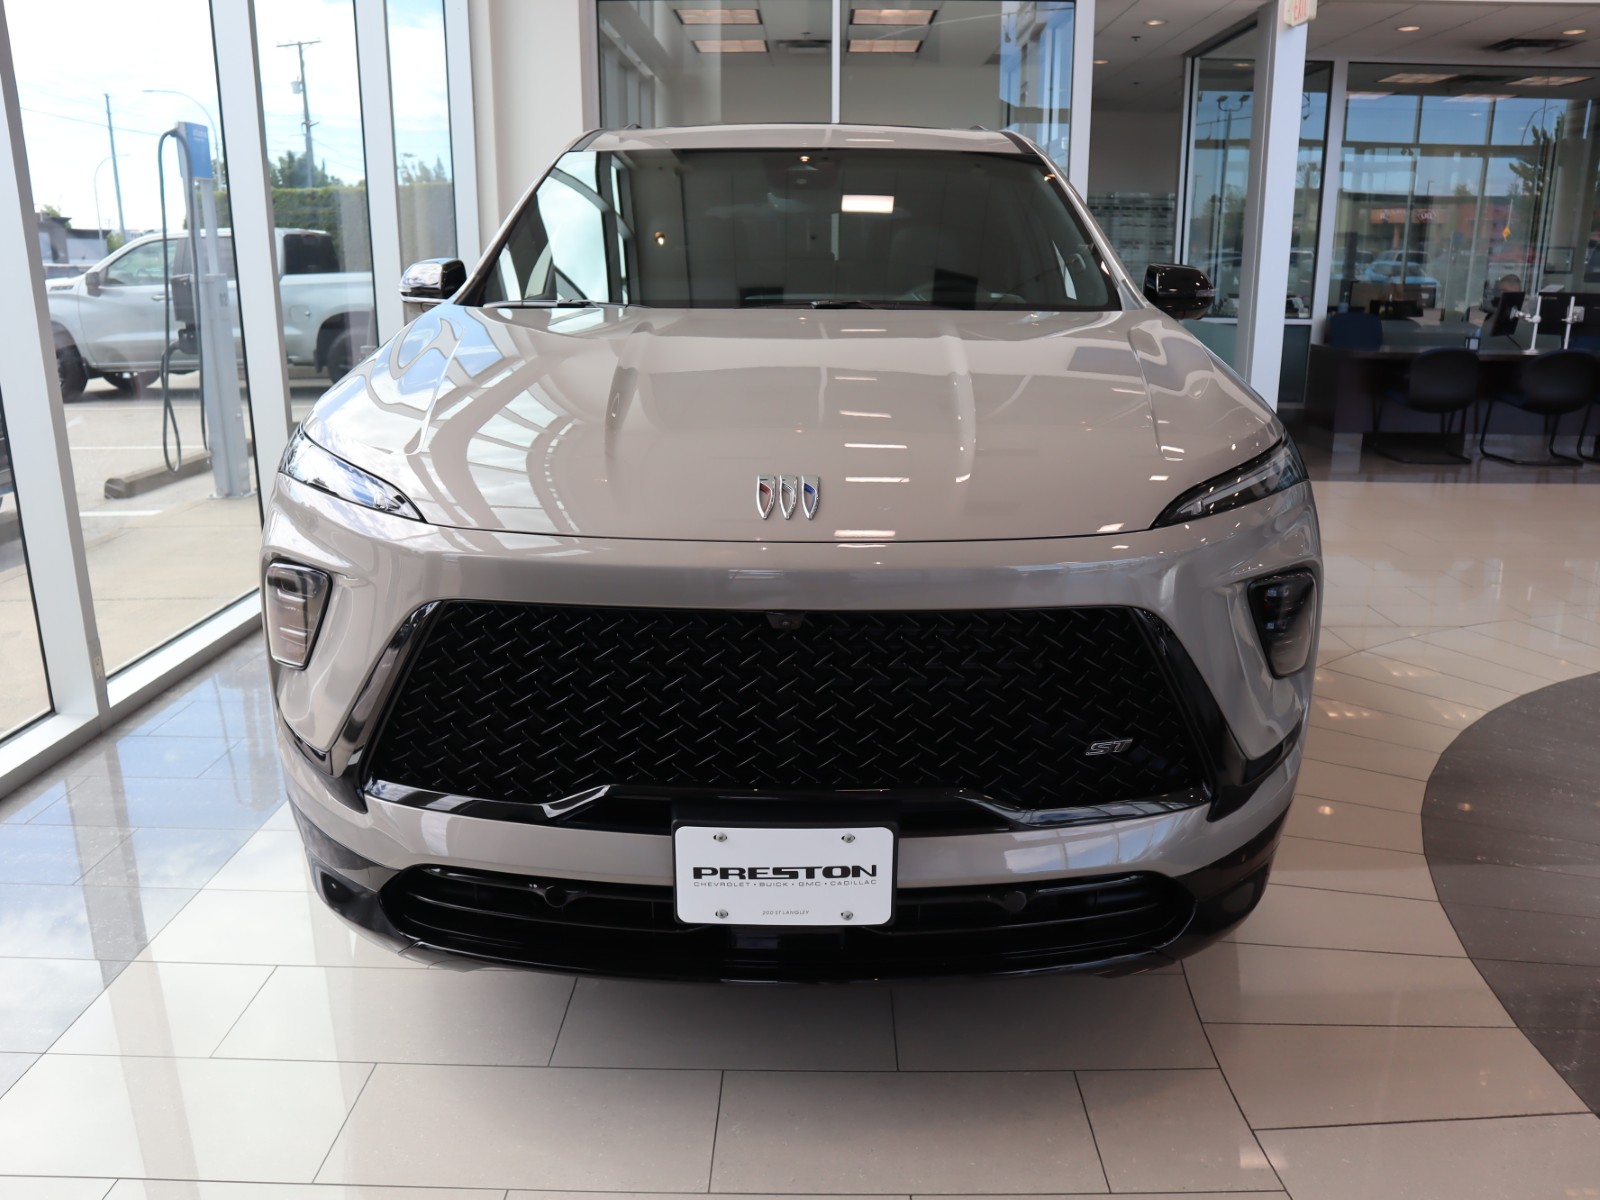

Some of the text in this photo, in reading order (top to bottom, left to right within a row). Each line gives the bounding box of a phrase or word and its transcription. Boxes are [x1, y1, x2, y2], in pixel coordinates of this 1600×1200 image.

[1085, 738, 1134, 756] ST
[693, 864, 877, 880] PRESTON
[830, 879, 877, 887] CADILLAC
